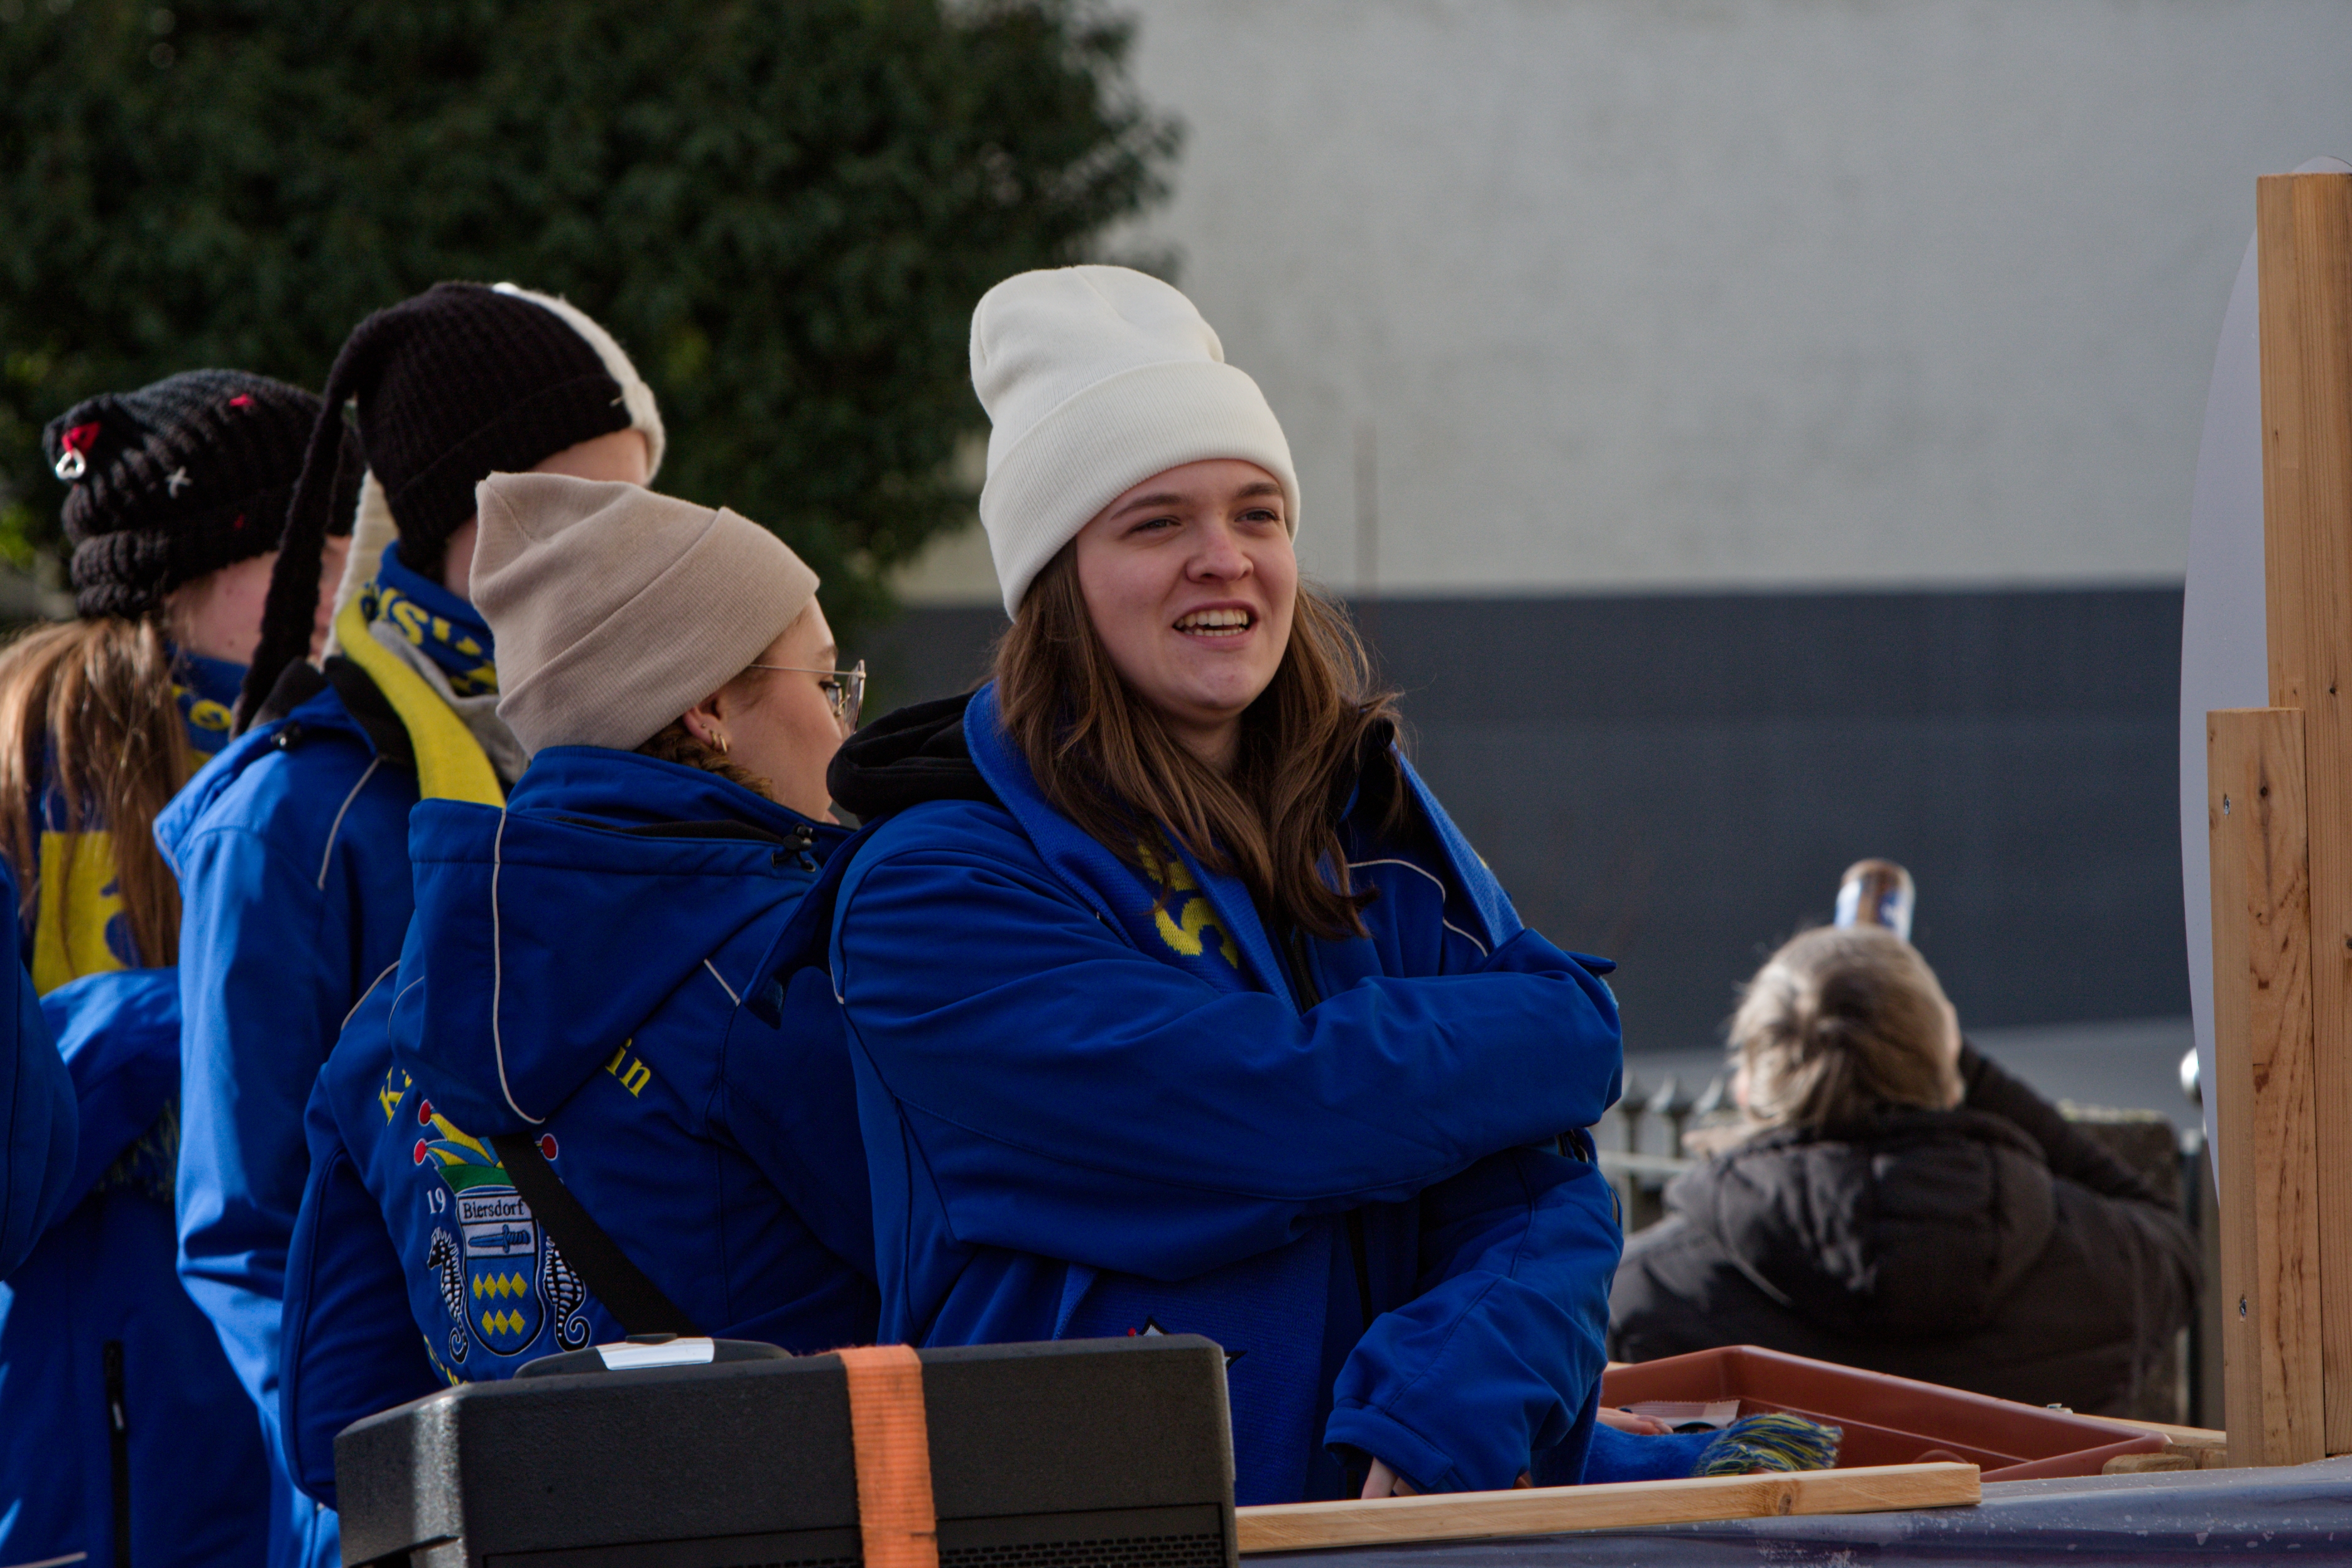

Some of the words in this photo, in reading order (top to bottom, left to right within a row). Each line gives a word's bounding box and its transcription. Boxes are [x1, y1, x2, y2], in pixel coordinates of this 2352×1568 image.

[378, 1066, 412, 1126] K
[427, 1187, 447, 1214] 19
[462, 1198, 525, 1219] Biersdorf
